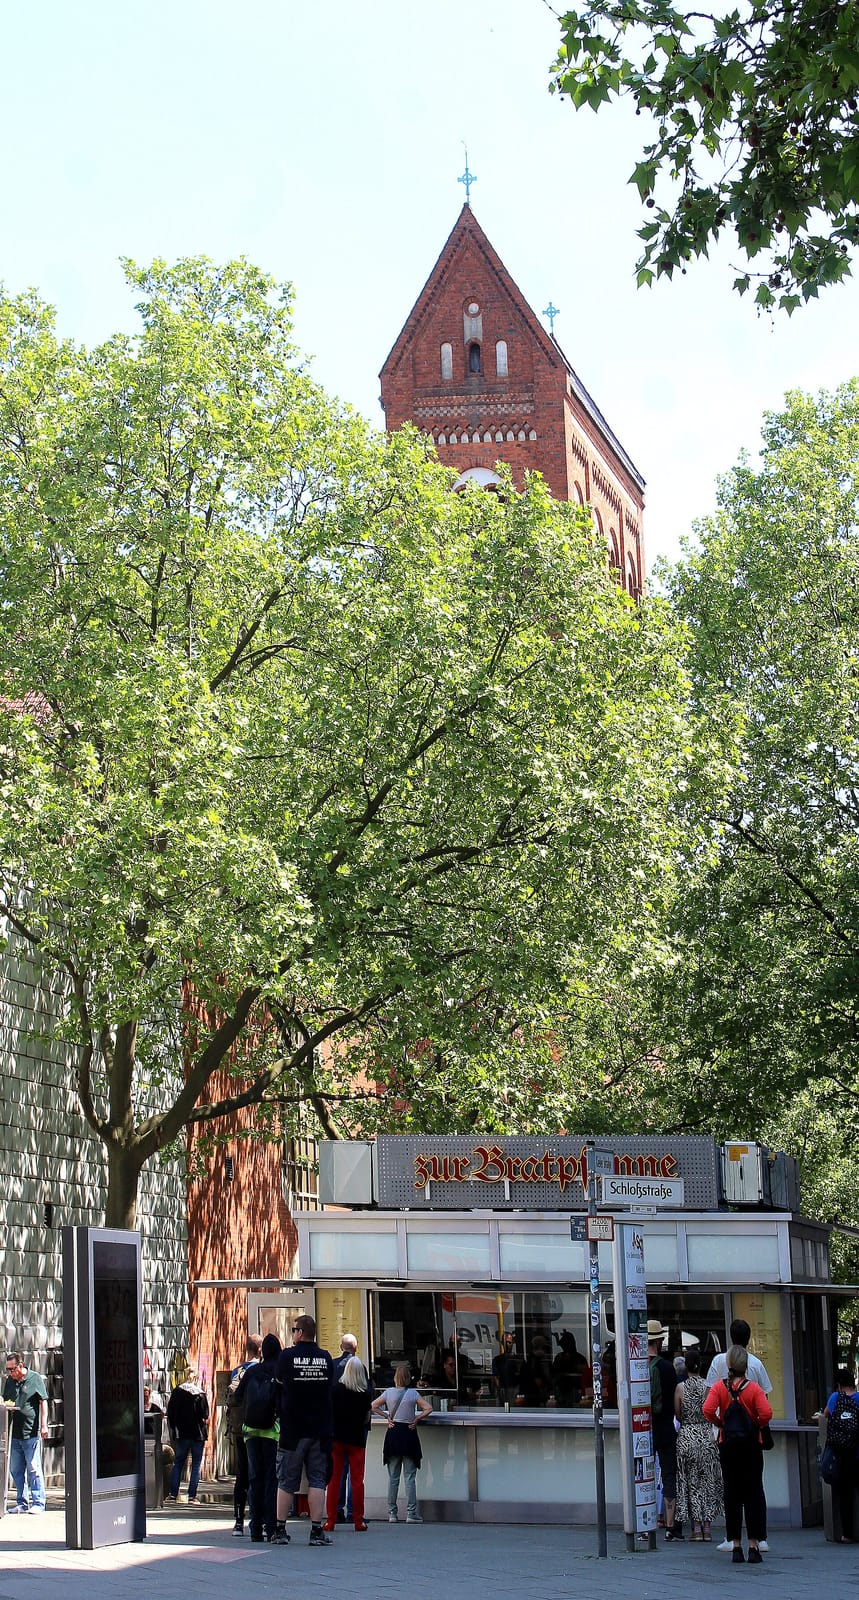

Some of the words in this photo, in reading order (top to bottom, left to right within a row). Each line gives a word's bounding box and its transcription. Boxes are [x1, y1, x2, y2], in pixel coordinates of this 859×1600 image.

[413, 1153, 470, 1189] zur
[470, 1144, 679, 1193] Bratpfnne
[610, 1181, 673, 1200] Schloßstraße
